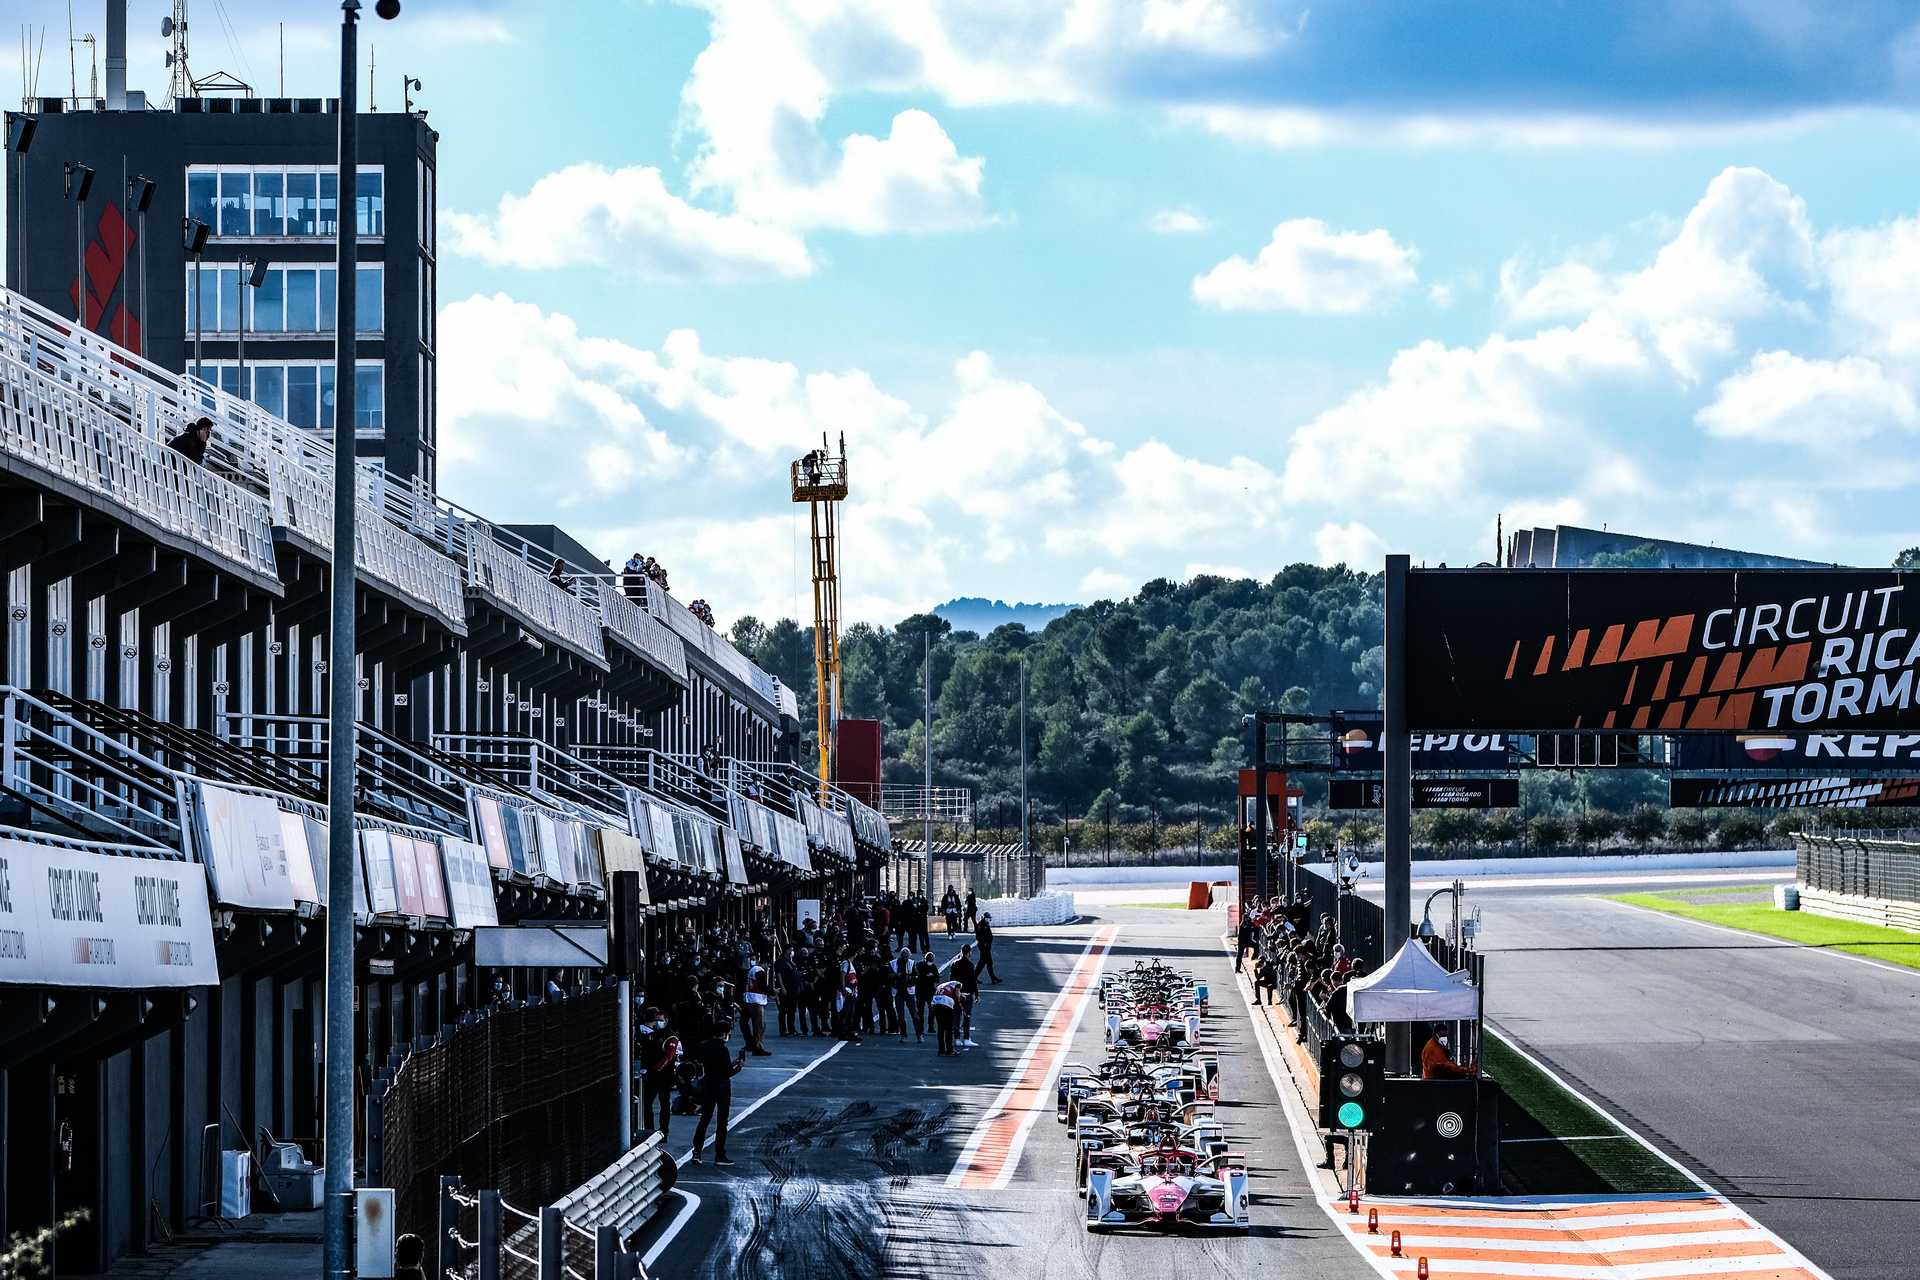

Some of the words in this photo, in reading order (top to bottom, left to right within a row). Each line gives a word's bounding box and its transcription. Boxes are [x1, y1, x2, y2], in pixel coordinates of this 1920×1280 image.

[1702, 585, 1904, 650] CIRCUIT
[1763, 669, 1920, 728] TORM
[1378, 731, 1505, 752] EPSOL
[1805, 734, 1920, 758] REP
[48, 866, 75, 921] CIRCUIT
[74, 868, 104, 923] LOUNGE
[134, 875, 158, 925] CIRCUIT
[156, 877, 182, 927] LOUNGE
